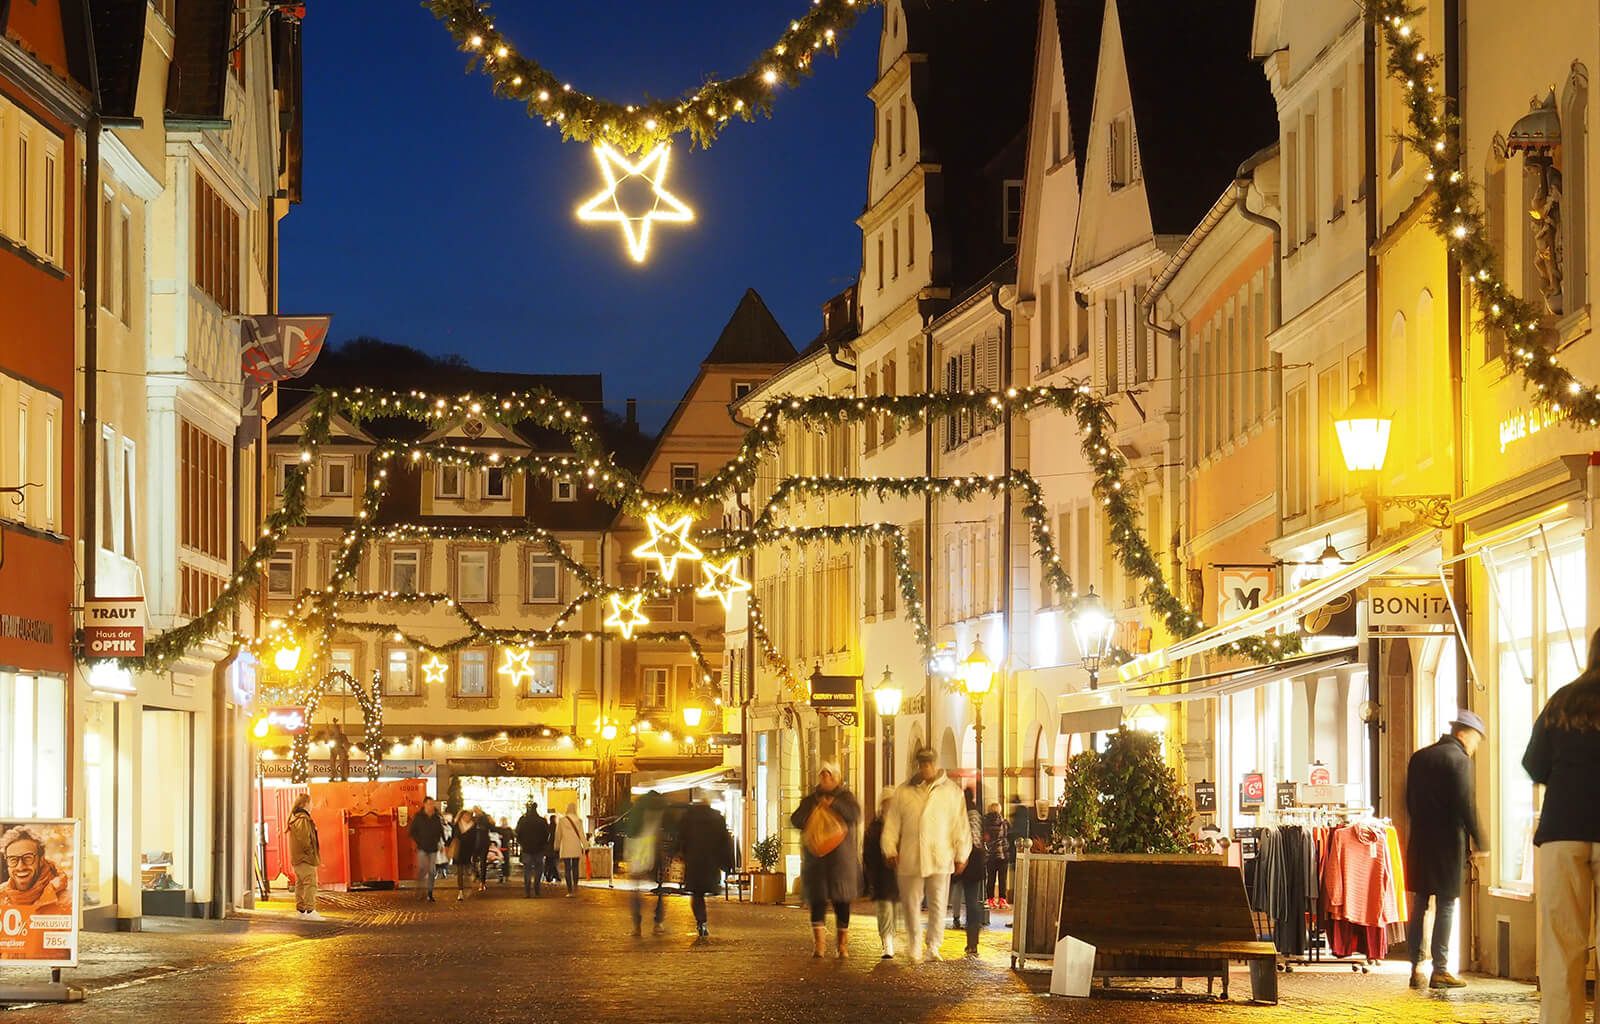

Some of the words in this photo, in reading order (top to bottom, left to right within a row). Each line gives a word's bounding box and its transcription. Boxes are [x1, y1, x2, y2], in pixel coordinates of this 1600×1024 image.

[1234, 588, 1261, 611] M
[91, 608, 137, 619] TRAUT
[96, 630, 117, 639] Haus
[118, 630, 132, 639] der
[91, 640, 136, 652] OPTIK
[262, 764, 296, 773] Volksb
[0, 908, 28, 937] 0%
[33, 920, 70, 928] INKLUSIVE
